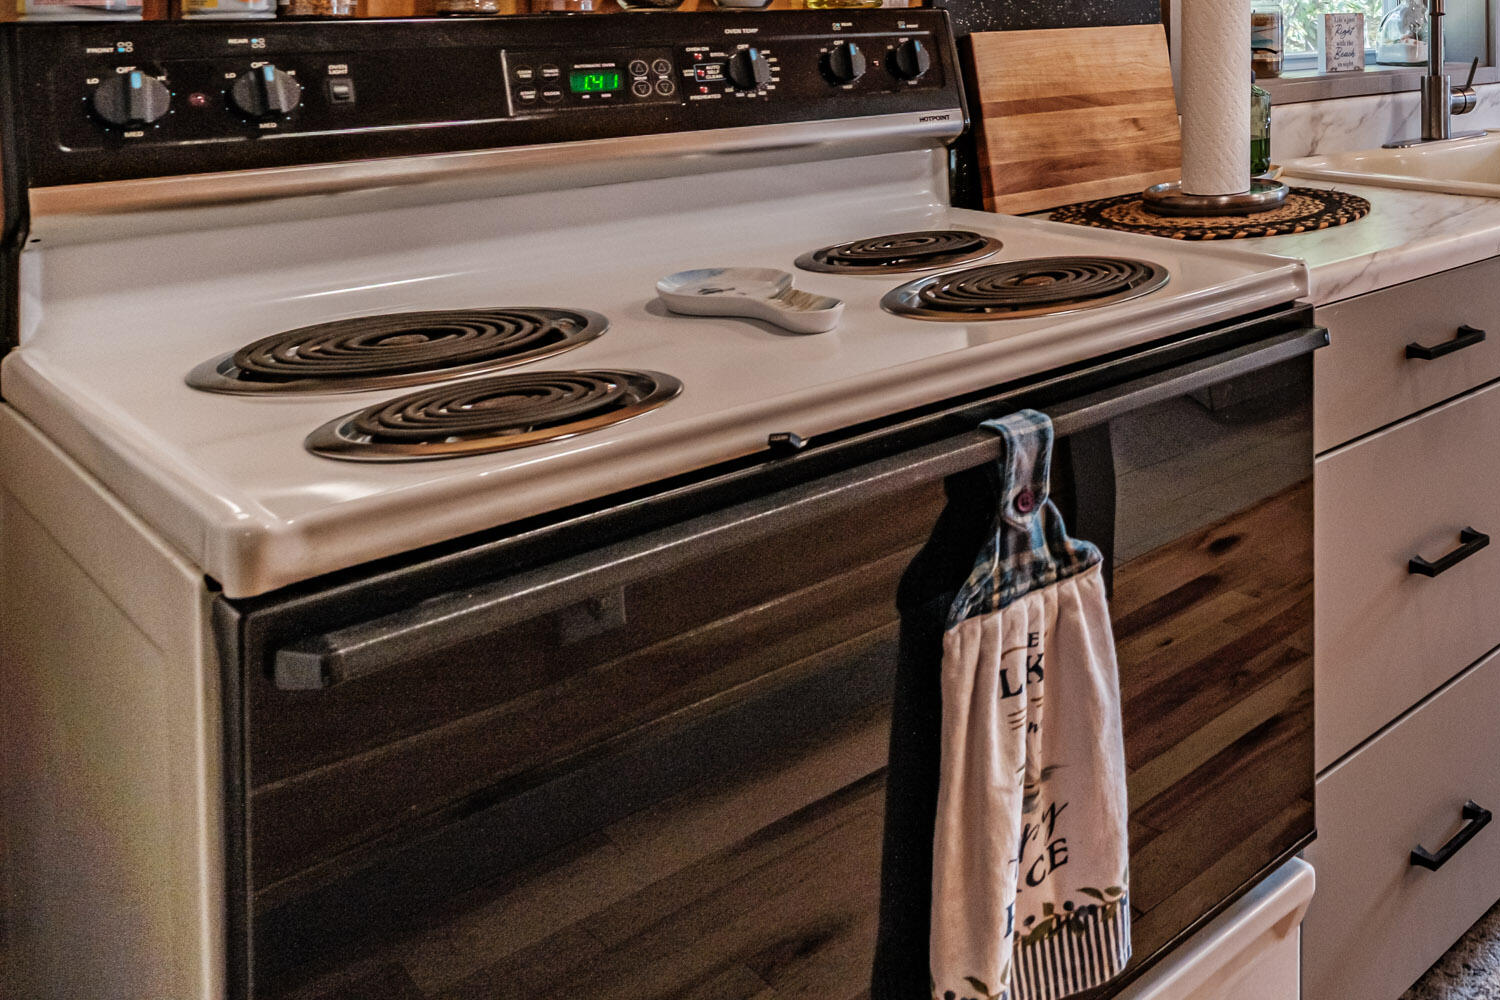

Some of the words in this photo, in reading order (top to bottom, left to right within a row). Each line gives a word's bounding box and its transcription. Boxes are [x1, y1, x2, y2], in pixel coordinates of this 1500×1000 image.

[1335, 23, 1355, 40] Right
[1333, 46, 1355, 60] Beach
[919, 114, 950, 123] HOTPOINT
